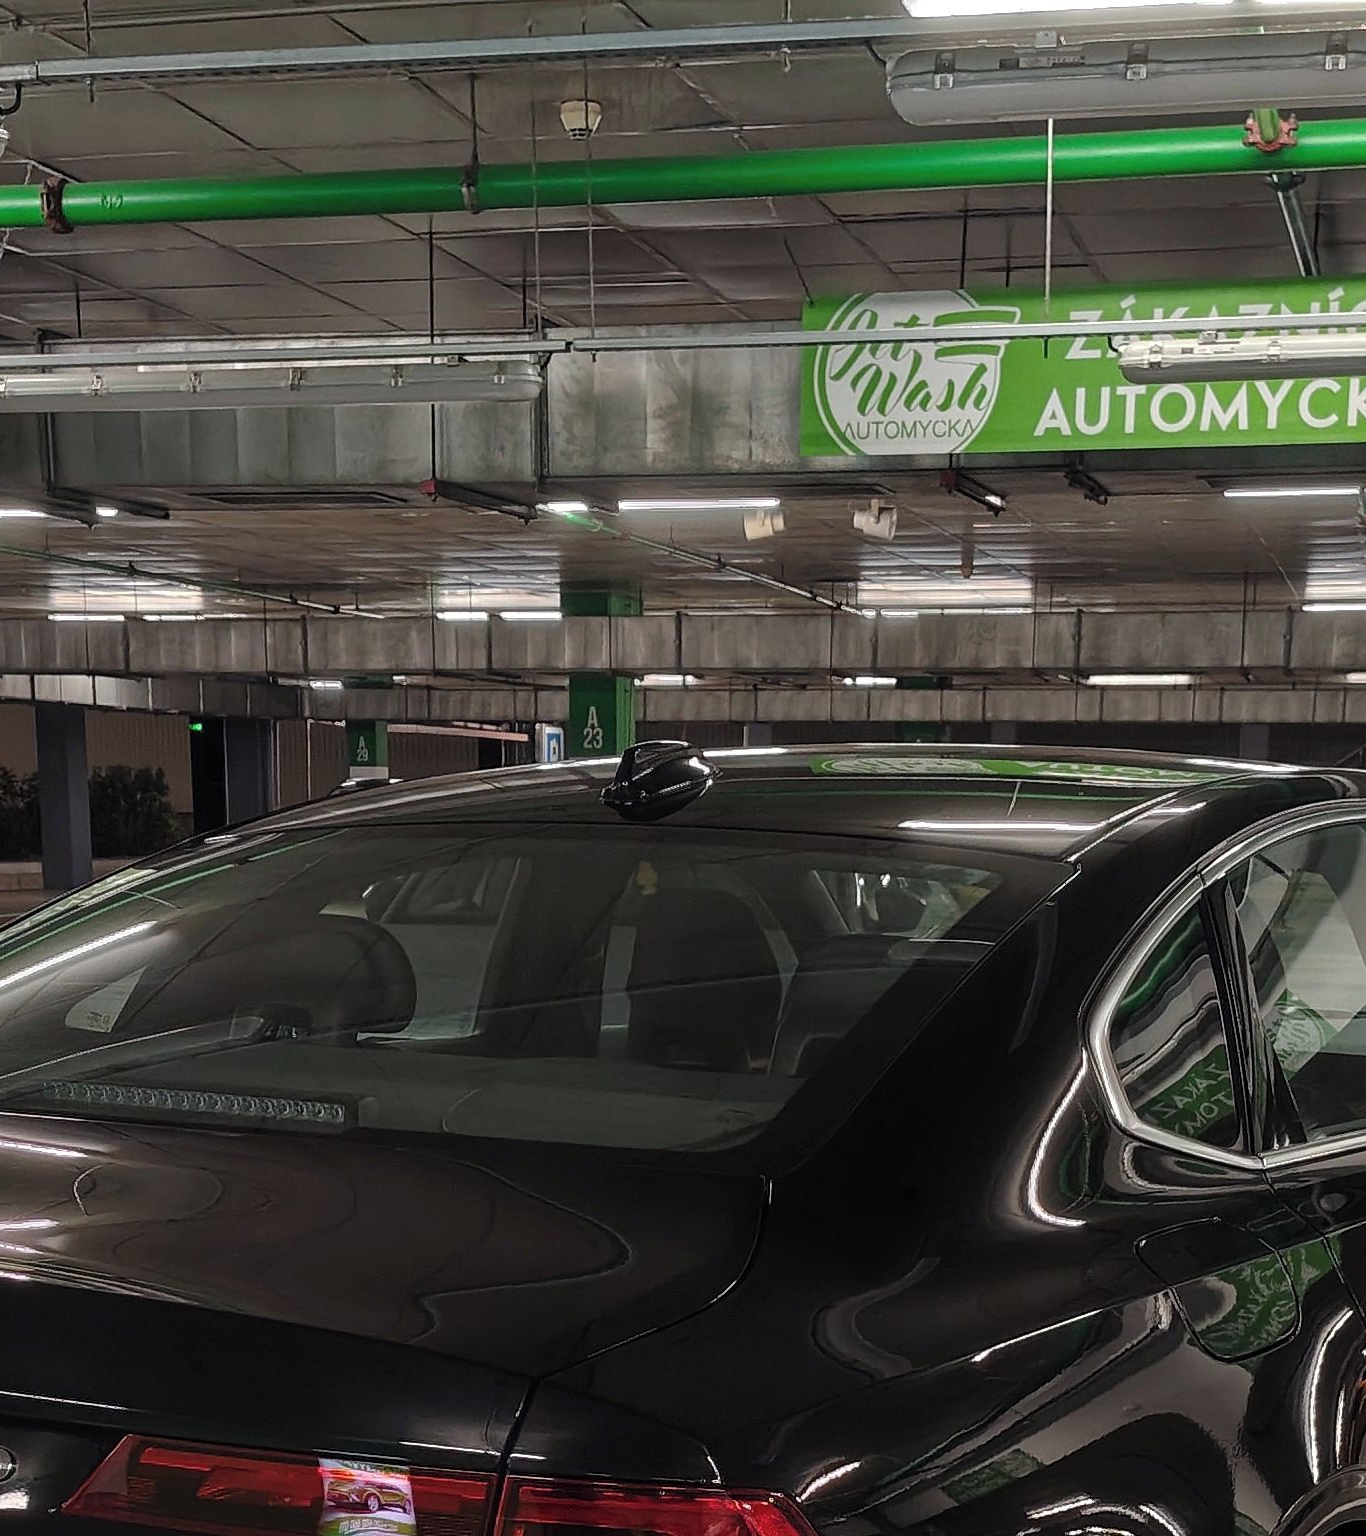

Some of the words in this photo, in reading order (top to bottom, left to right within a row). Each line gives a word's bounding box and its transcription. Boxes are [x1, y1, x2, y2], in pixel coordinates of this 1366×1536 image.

[850, 350, 989, 417] Wash
[587, 706, 597, 728] A
[358, 735, 366, 749] A
[583, 728, 603, 749] 23
